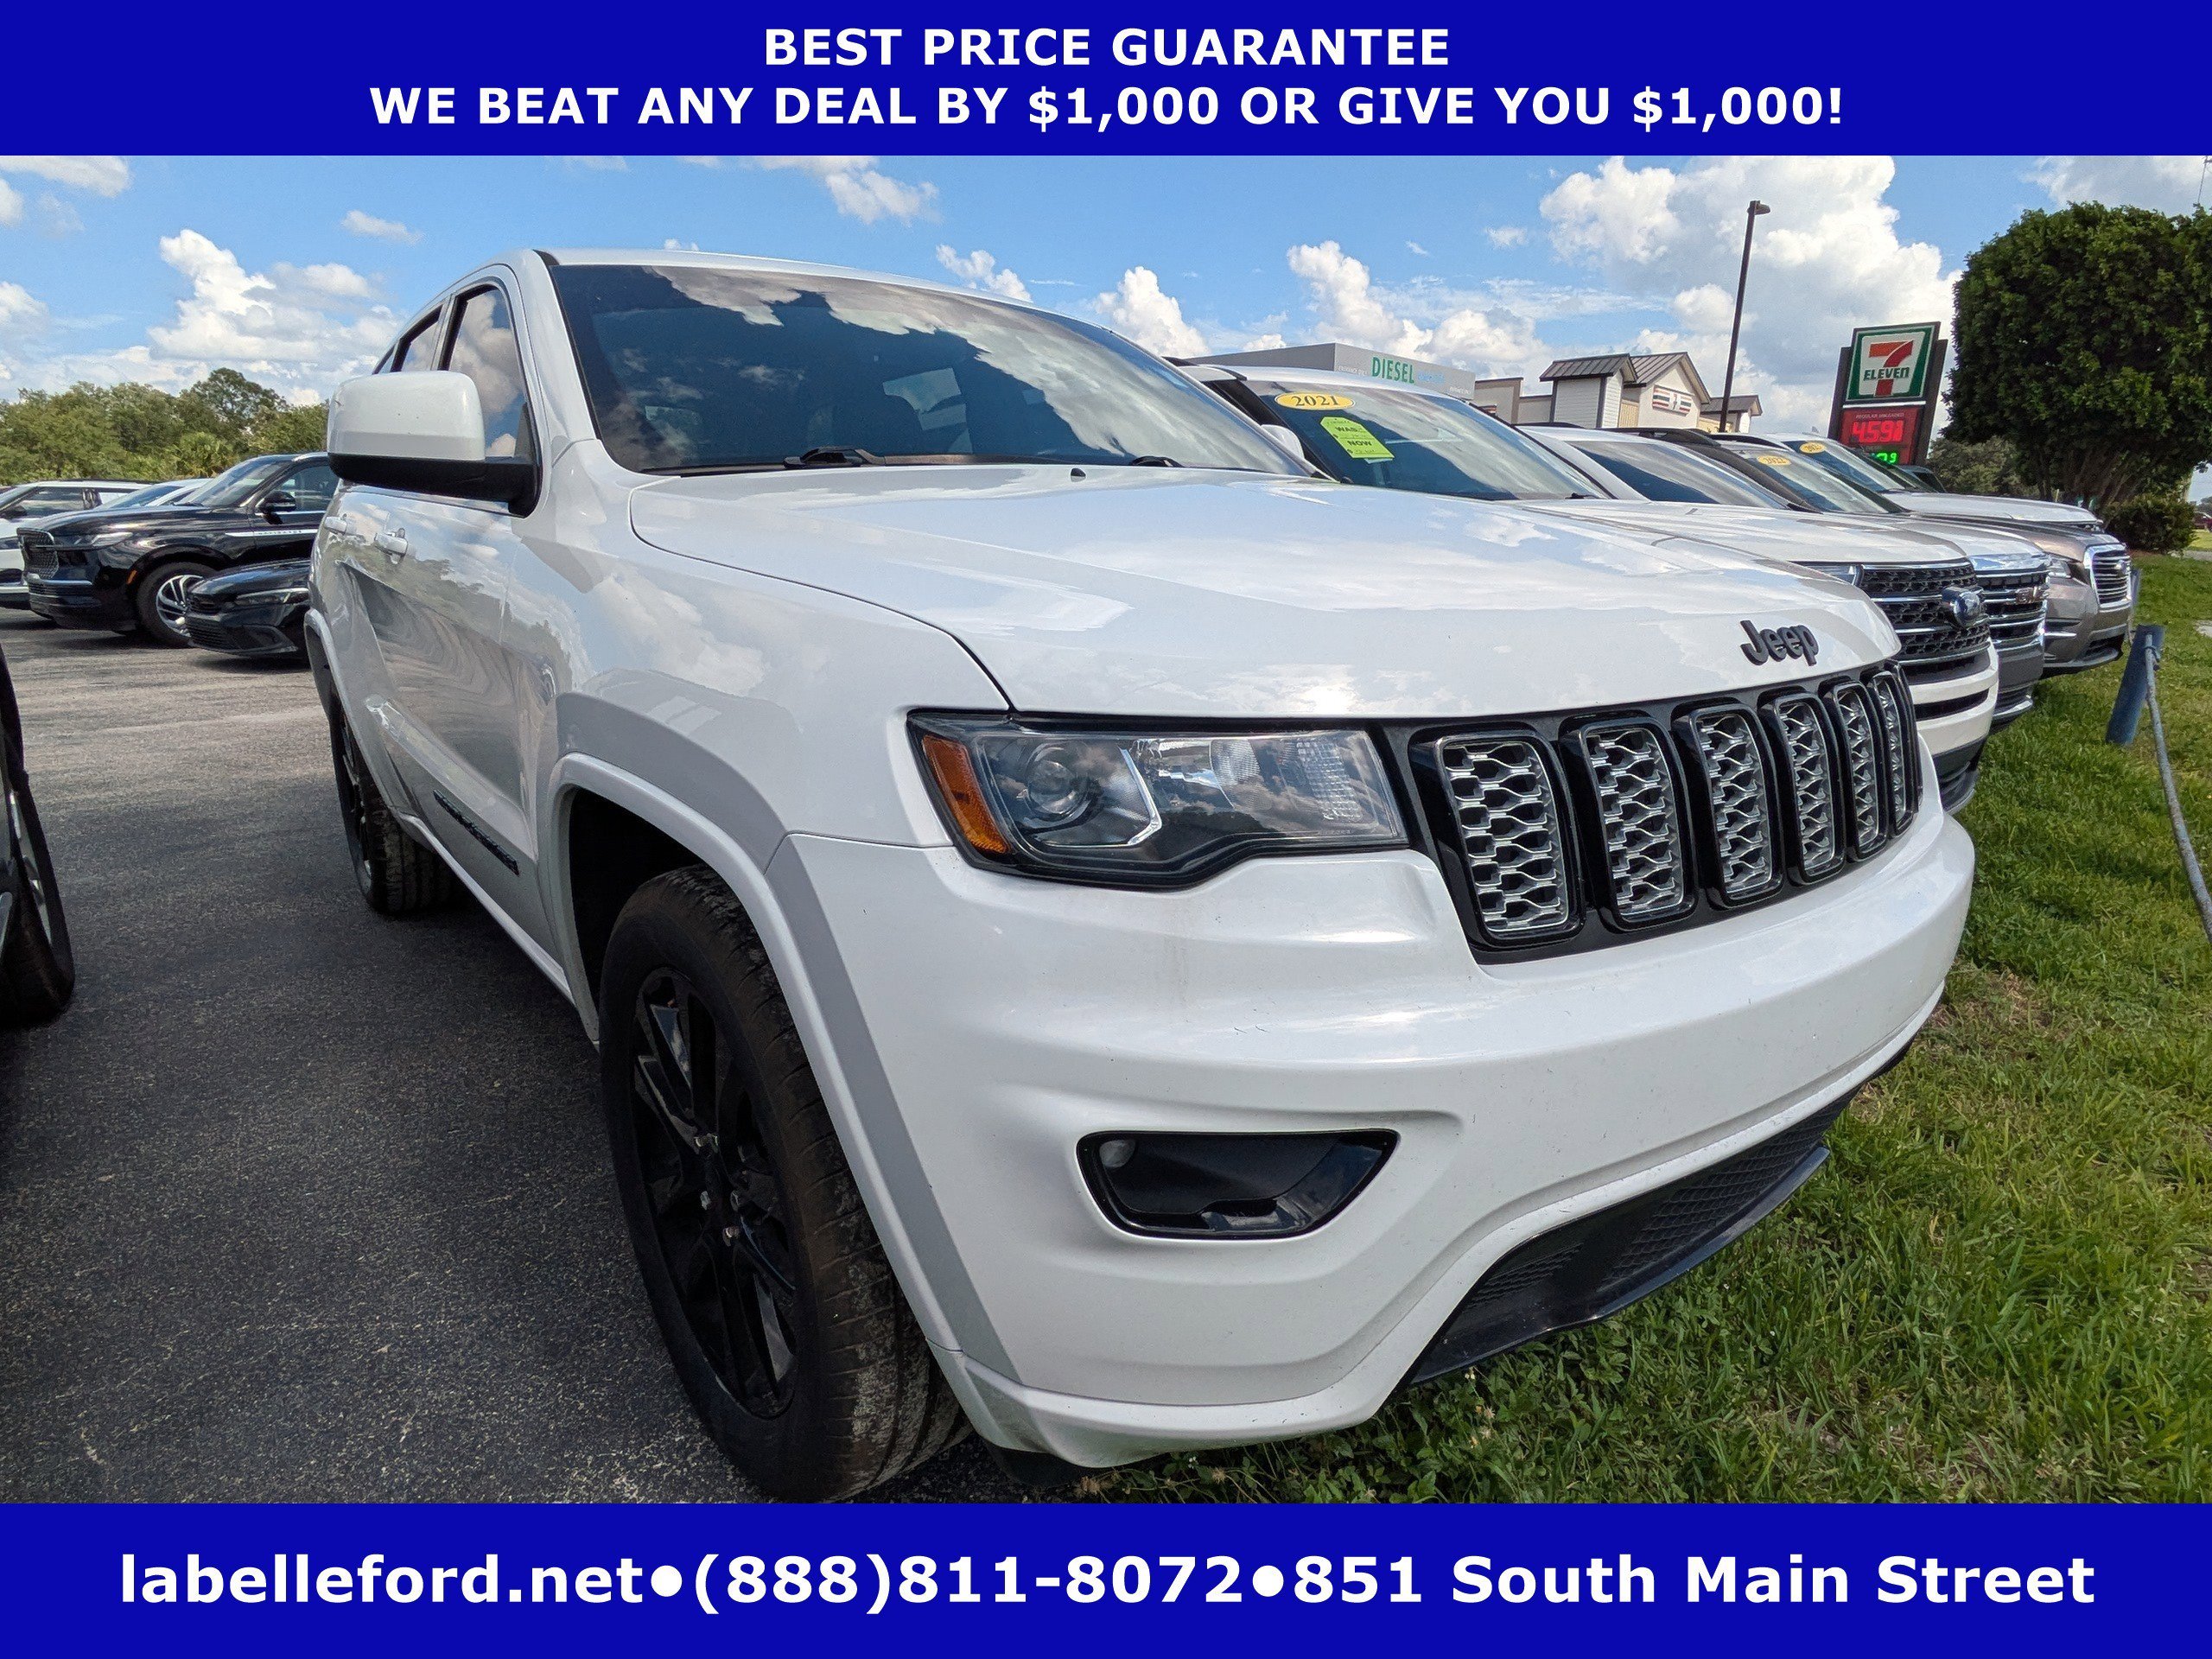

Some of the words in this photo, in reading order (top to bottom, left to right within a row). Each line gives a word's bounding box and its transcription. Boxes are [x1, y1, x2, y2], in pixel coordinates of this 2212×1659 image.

[1371, 356, 1414, 384] DIESEL
[1869, 340, 1914, 397] 7
[1291, 395, 1338, 407] 2021
[1739, 620, 1819, 667] Jeep
